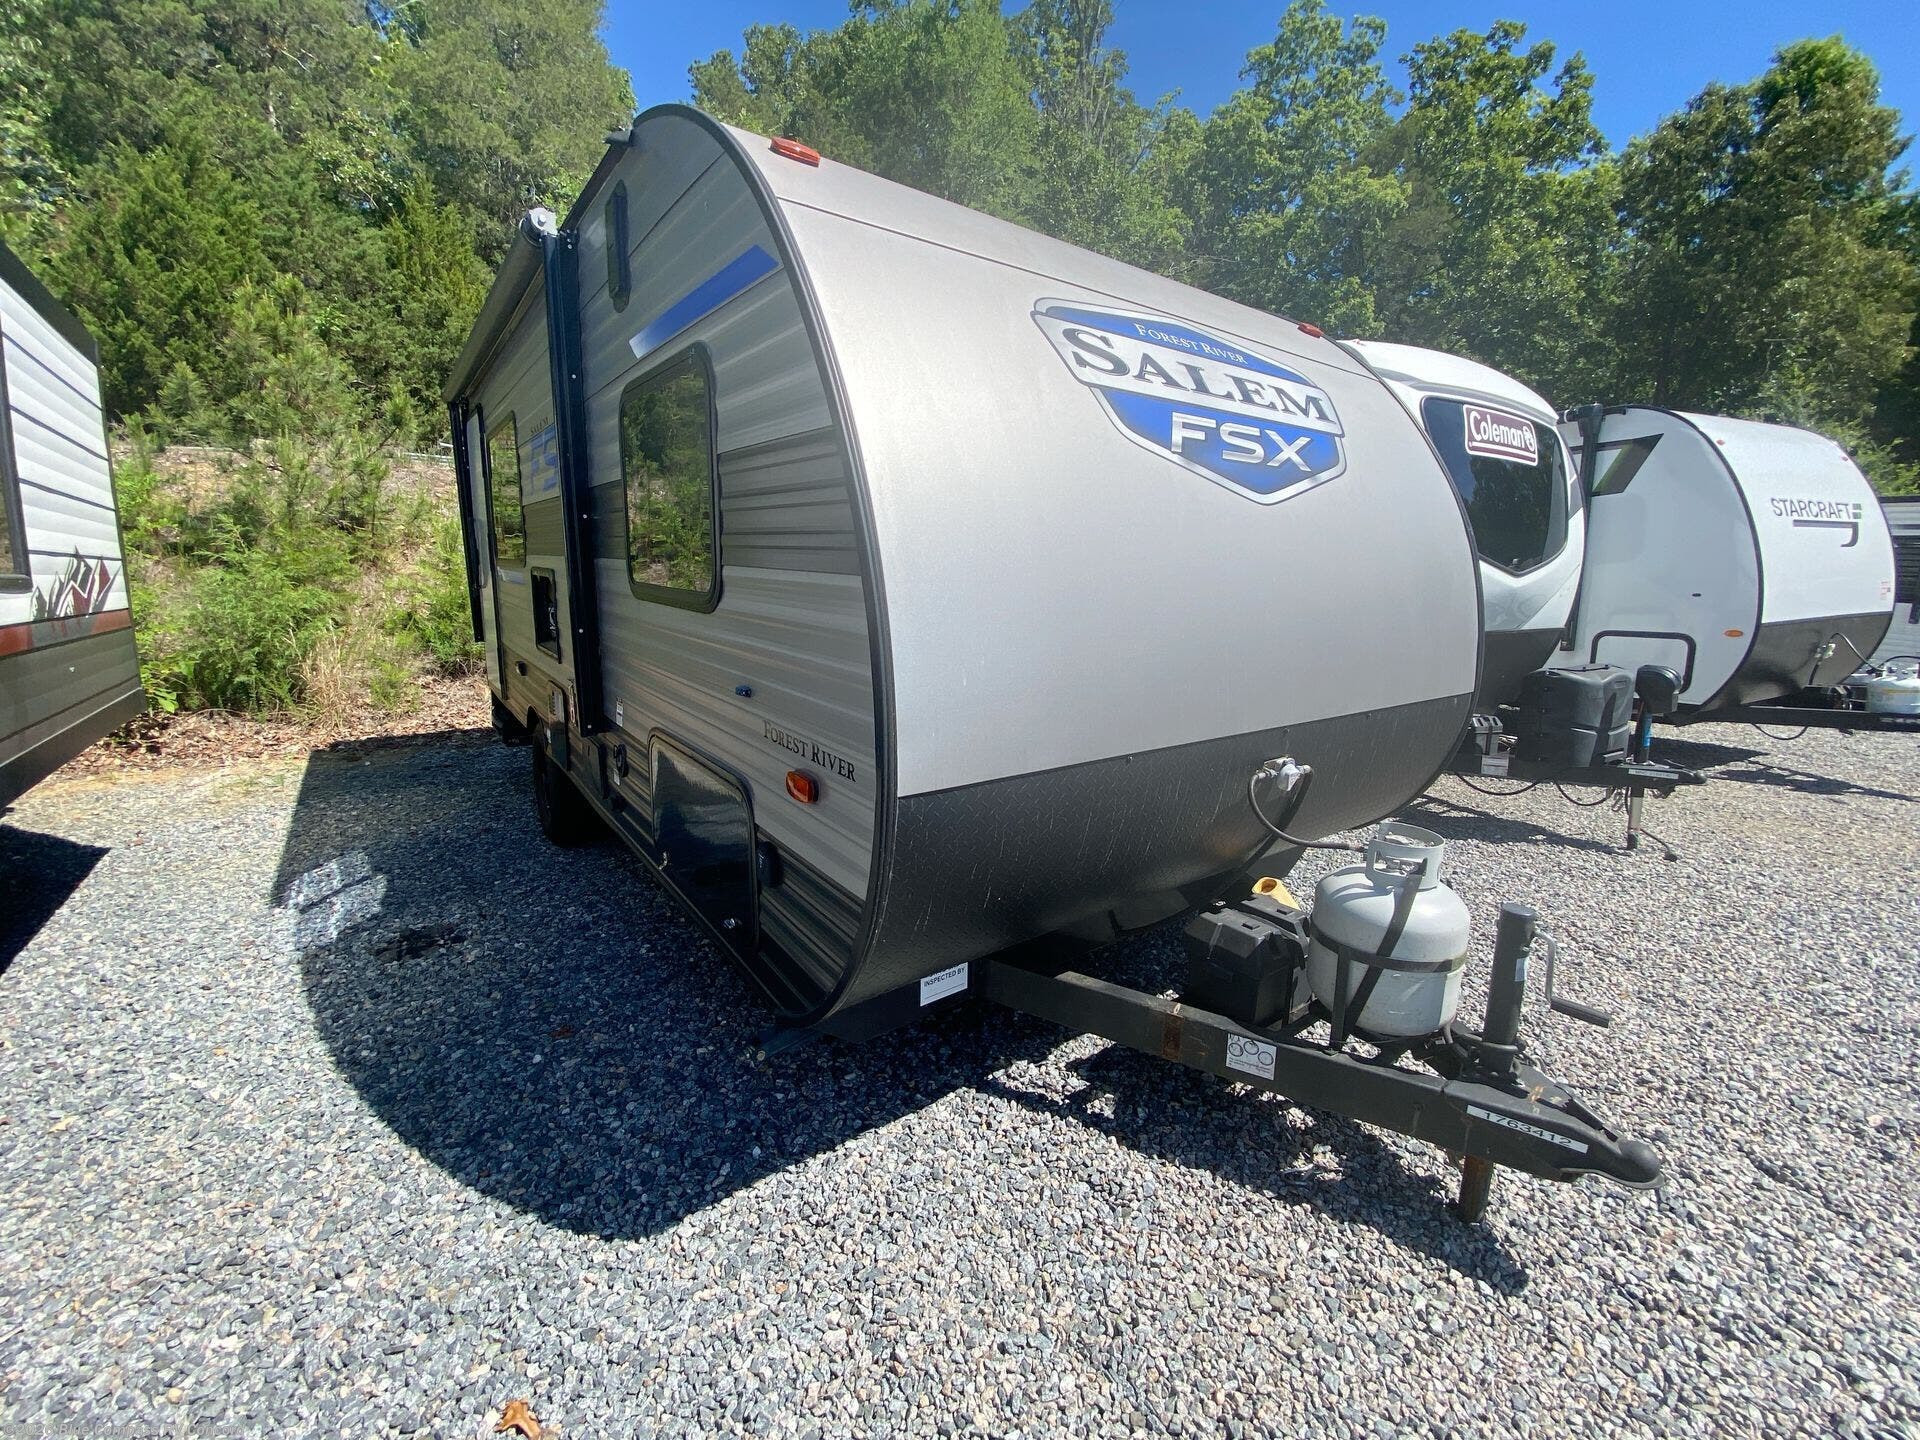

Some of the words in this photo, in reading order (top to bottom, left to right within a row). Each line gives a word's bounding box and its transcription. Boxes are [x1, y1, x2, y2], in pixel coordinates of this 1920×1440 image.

[1133, 322, 1199, 353] FOREST
[1200, 339, 1248, 366] RIVER
[1062, 328, 1338, 425] SALEM
[1170, 411, 1312, 473] FSX
[1469, 410, 1525, 450] Coleman
[1770, 497, 1852, 520] STARCRAFT
[763, 719, 810, 759] FOREST
[810, 742, 857, 783] RIVER
[923, 970, 957, 988] INSPECTED
[957, 966, 966, 975] BY
[1483, 1111, 1573, 1147] 1763412
